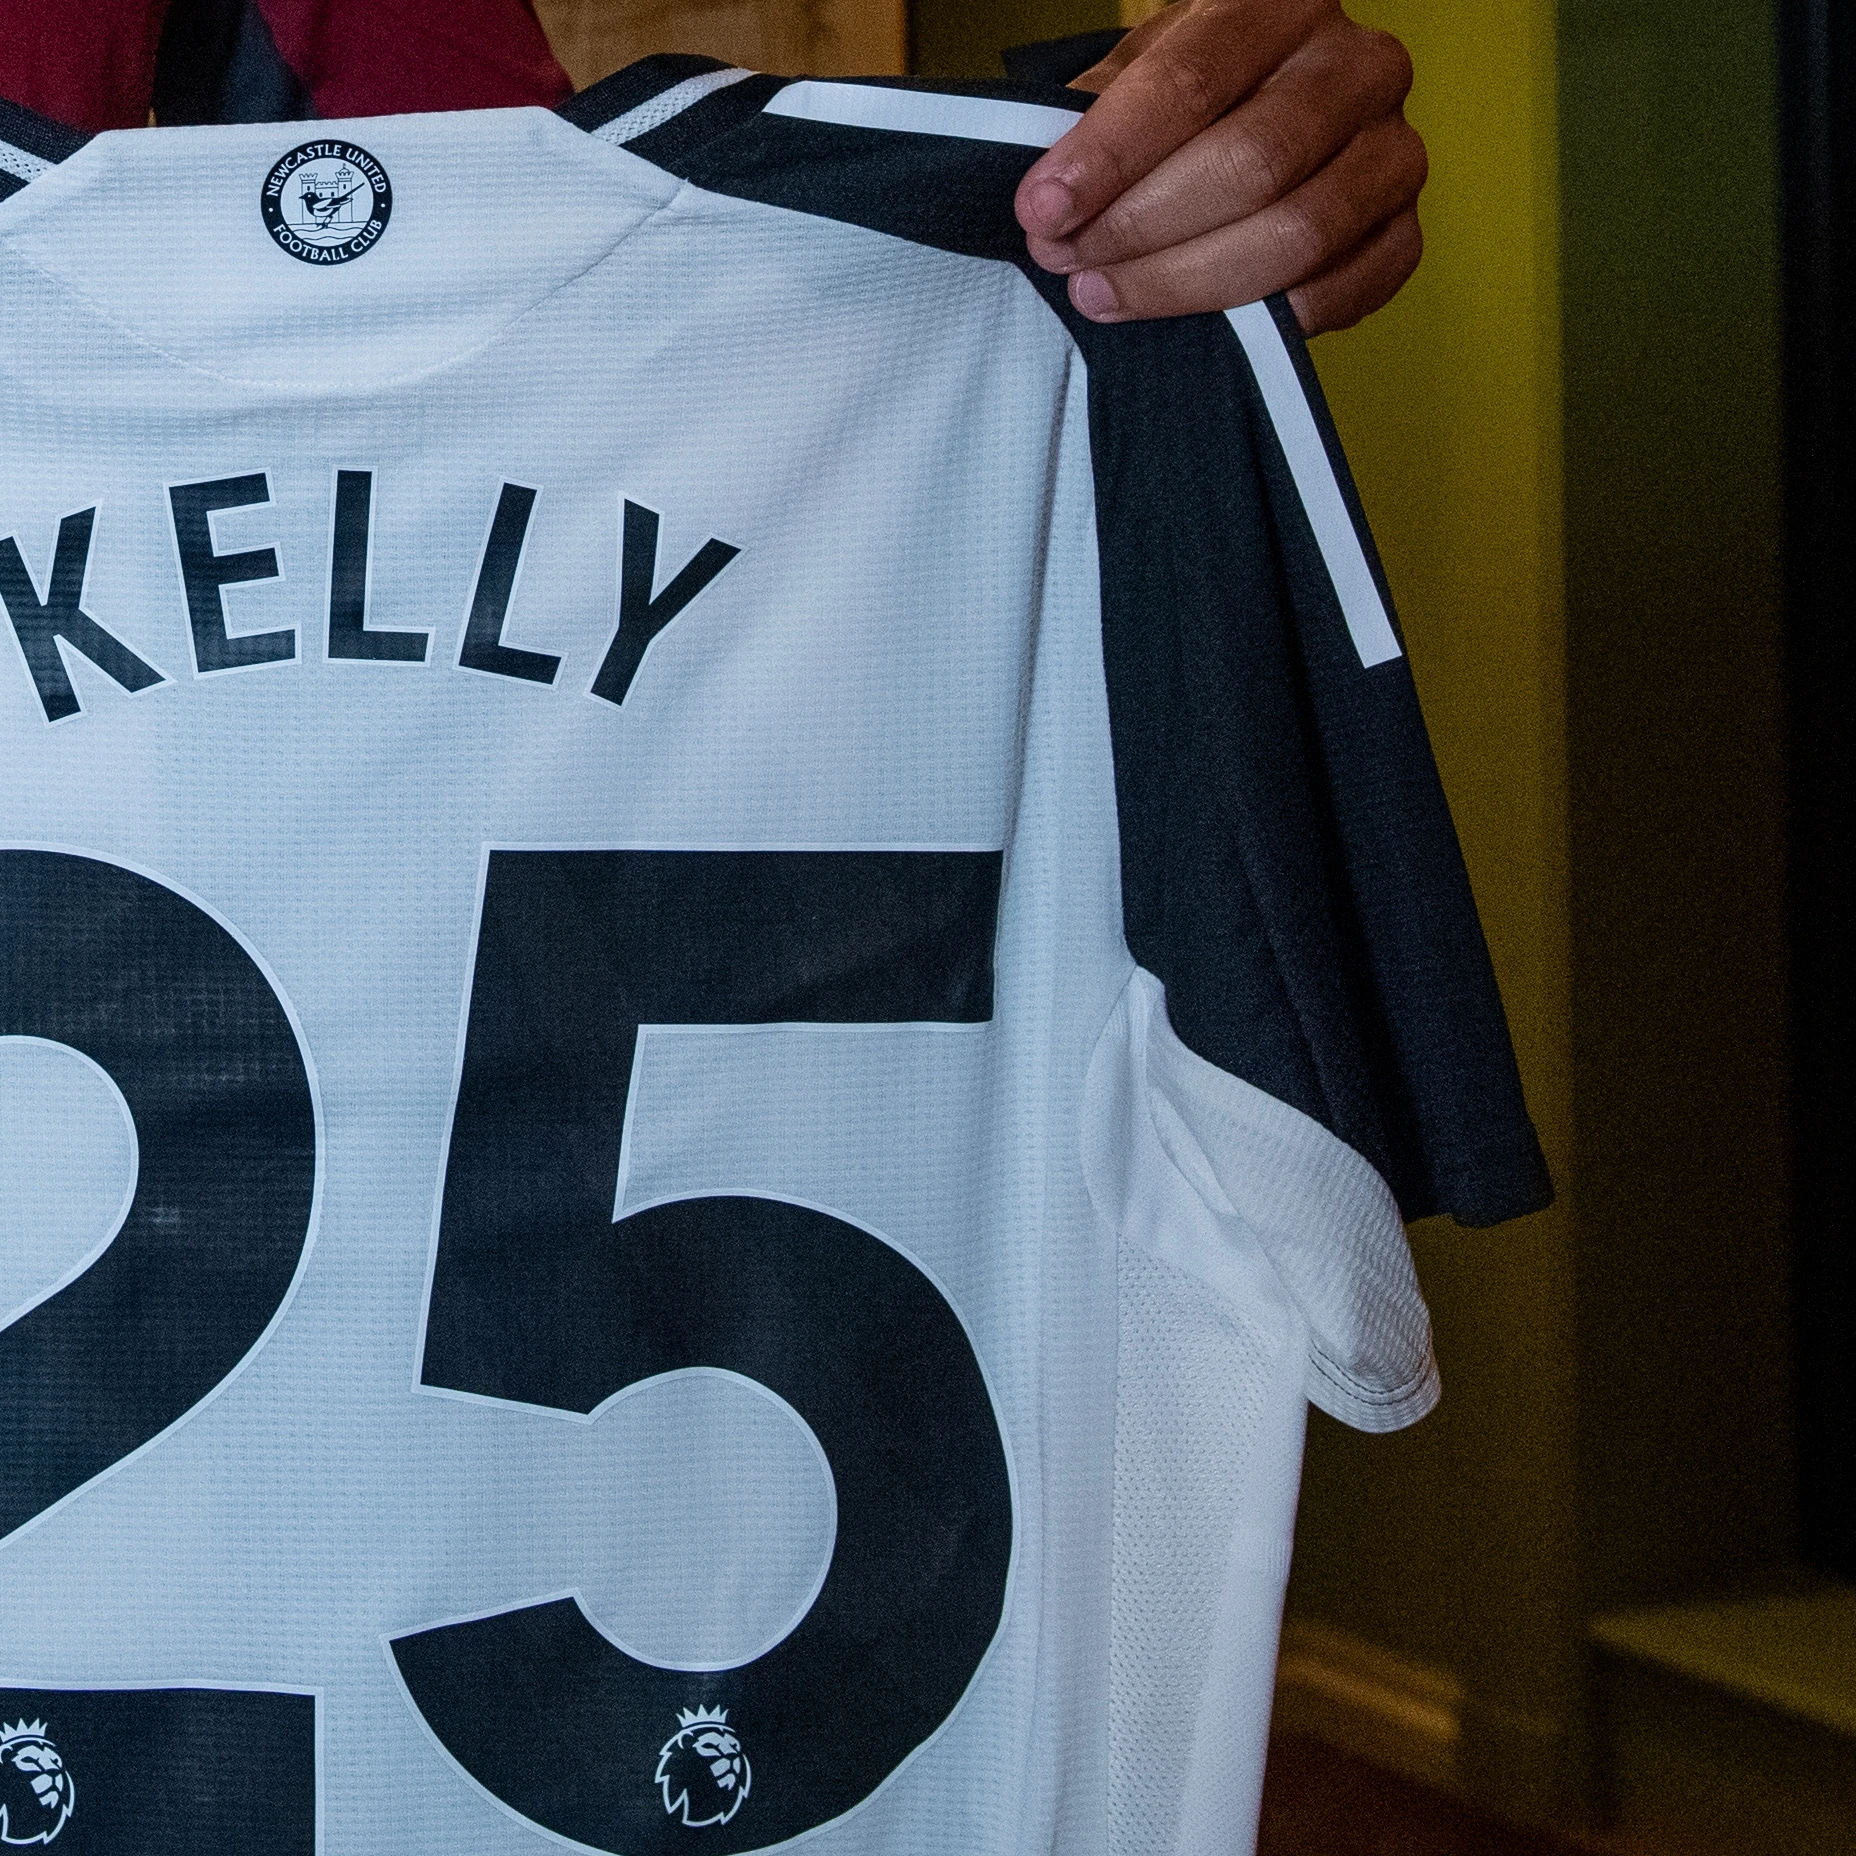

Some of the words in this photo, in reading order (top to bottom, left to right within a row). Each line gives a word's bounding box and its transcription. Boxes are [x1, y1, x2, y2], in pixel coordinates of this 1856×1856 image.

[266, 144, 342, 197] NEWCASTLE
[345, 148, 387, 193] UNITED
[273, 224, 349, 261] FOOTBALL
[350, 219, 382, 252] CLUB
